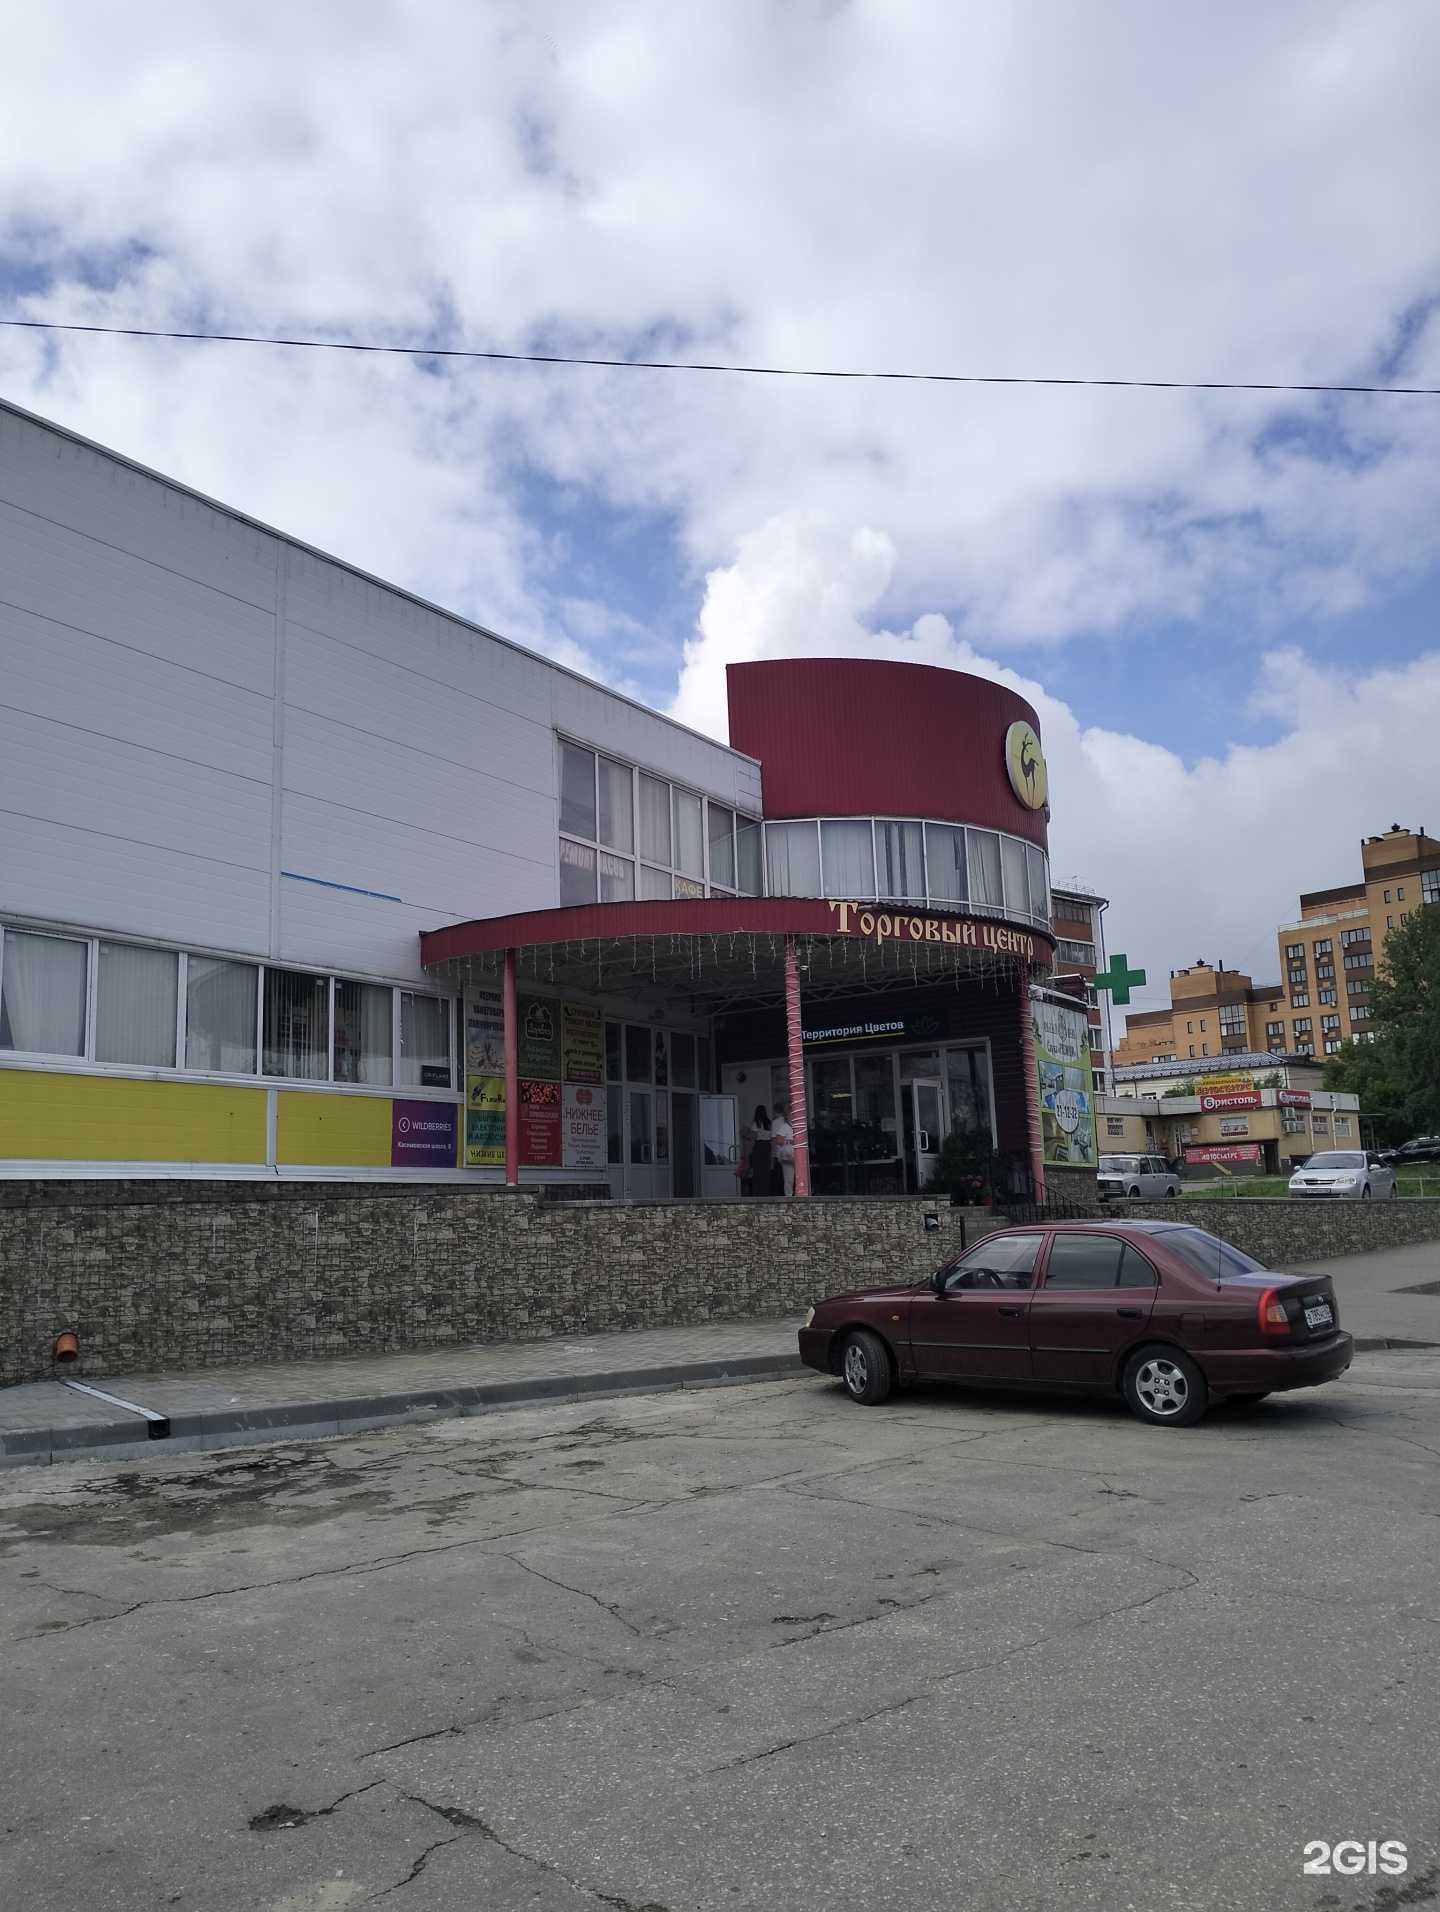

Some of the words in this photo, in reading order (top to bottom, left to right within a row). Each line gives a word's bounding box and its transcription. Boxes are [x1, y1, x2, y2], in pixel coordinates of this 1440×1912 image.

[675, 880, 703, 898] КАФЕ
[828, 901, 977, 946] Торговый
[802, 1026, 863, 1040] Территория
[865, 1021, 905, 1034] Цветов
[1203, 1096, 1257, 1109] Бристоль
[565, 1107, 604, 1122] НИЖНЕЕ
[411, 1121, 452, 1132] WILDBERRIES
[570, 1122, 599, 1135] БЕЛЬЕ
